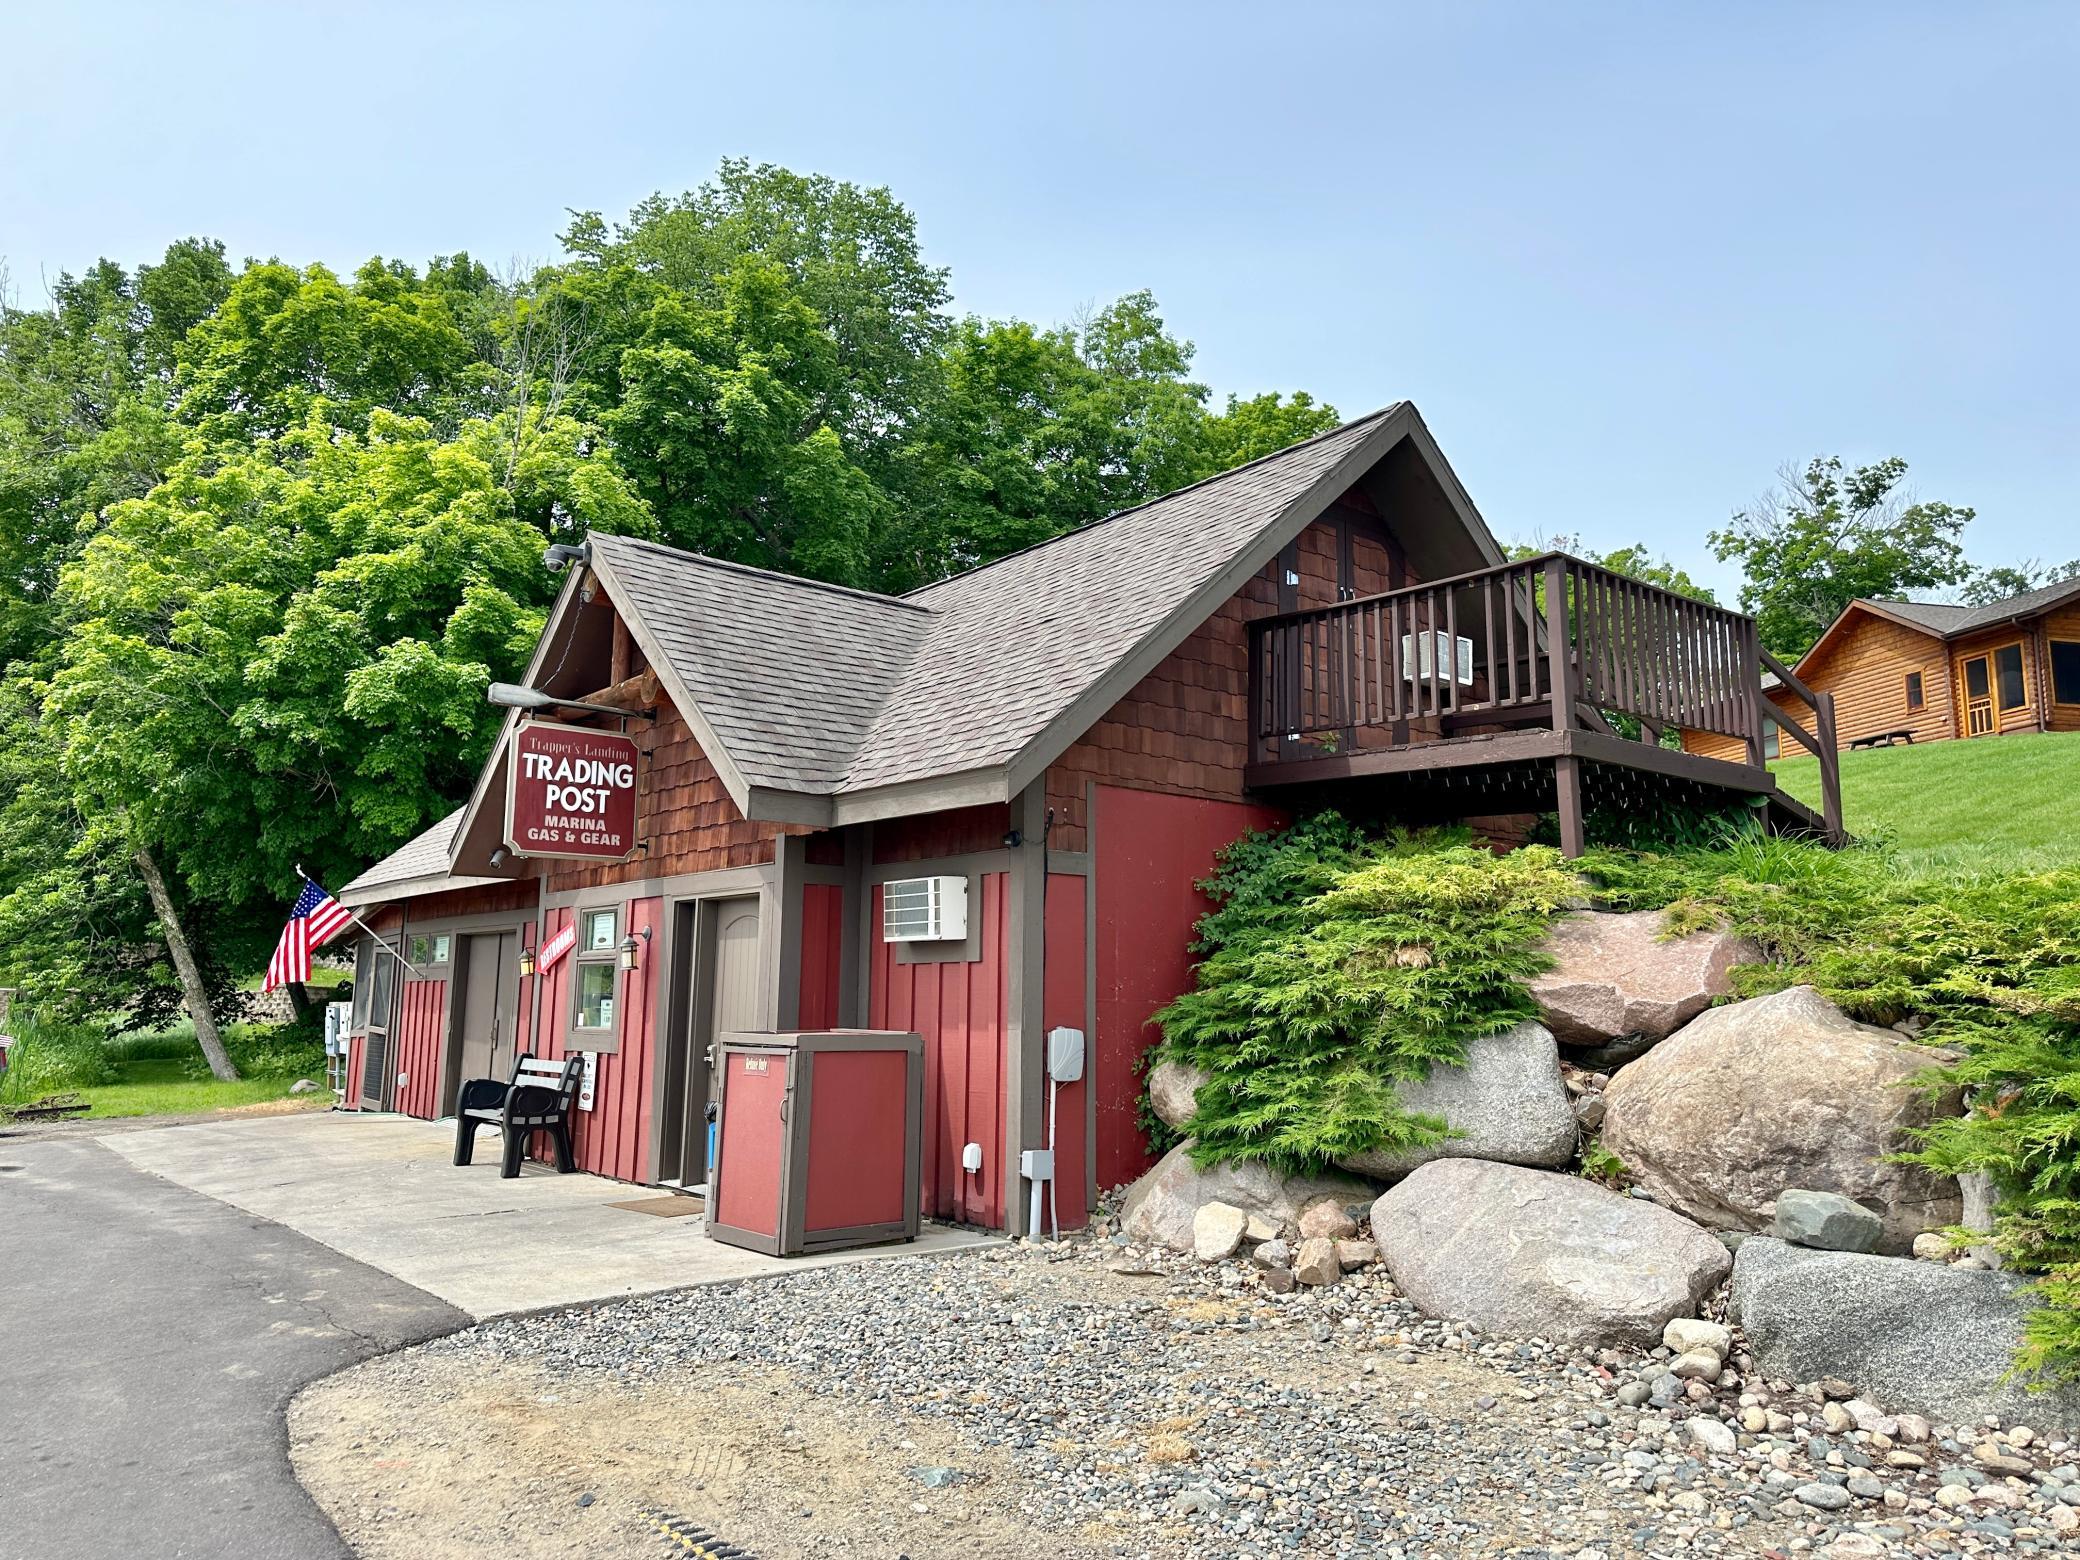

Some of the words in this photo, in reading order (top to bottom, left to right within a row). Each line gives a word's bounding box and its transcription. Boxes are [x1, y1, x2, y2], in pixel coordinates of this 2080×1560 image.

[530, 737, 580, 754] Trapper's
[585, 744, 629, 761] Landing
[522, 752, 634, 789] TRADING
[545, 784, 611, 814] POST
[544, 815, 607, 832] MARINA
[527, 828, 560, 842] GAS
[564, 830, 576, 843] &
[580, 832, 621, 846] GEAR
